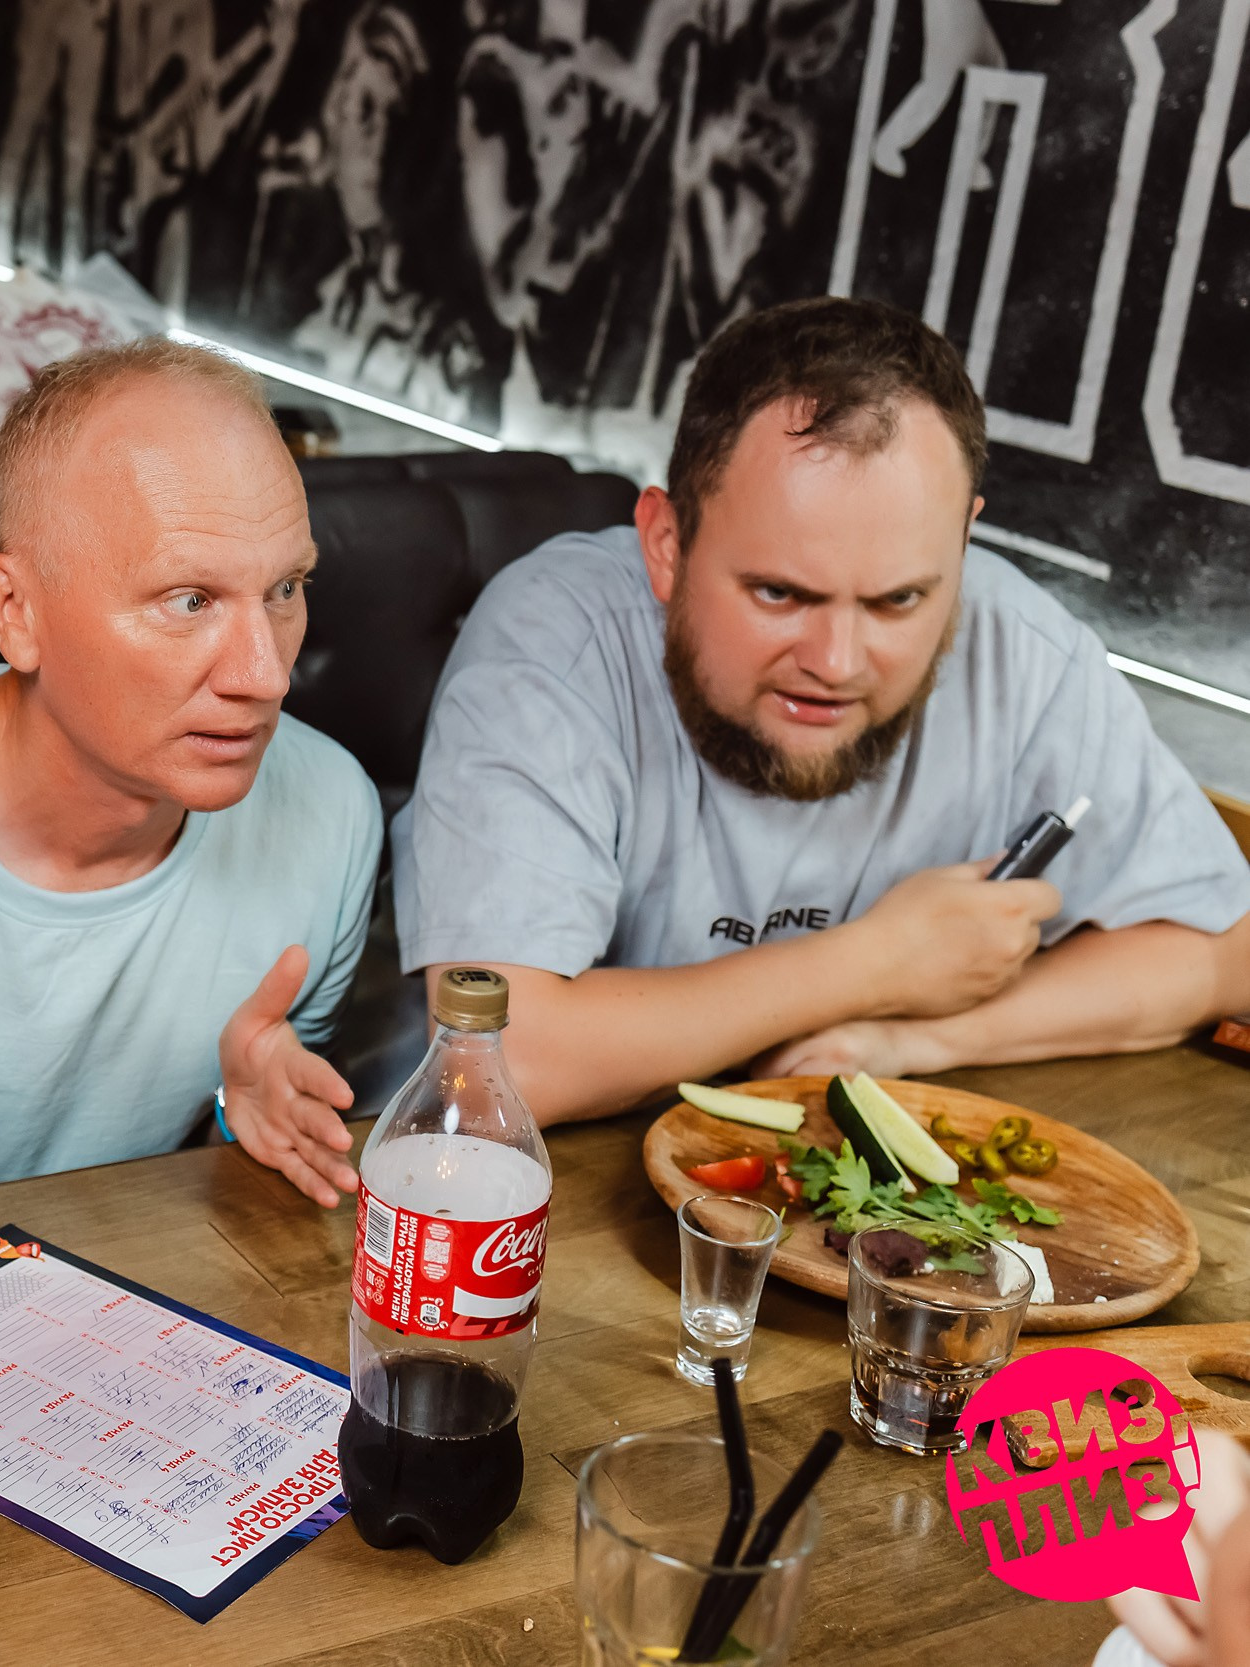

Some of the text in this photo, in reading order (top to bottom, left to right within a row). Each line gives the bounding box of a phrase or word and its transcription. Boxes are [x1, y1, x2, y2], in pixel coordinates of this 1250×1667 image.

[400, 1216, 419, 1325] ПЕРЕРАБОТАЙ МЕНЯ
[391, 1291, 402, 1320] МЕНІ
[45, 1391, 75, 1412] РАУНД
[104, 1419, 134, 1439] РАУНД
[166, 1449, 196, 1469] РАУНД
[295, 1449, 338, 1481] ДЛЯ
[230, 1482, 261, 1503] РАУНД
[259, 1476, 337, 1529] ПРОСТО
[211, 1528, 266, 1567] ЛИСТ
